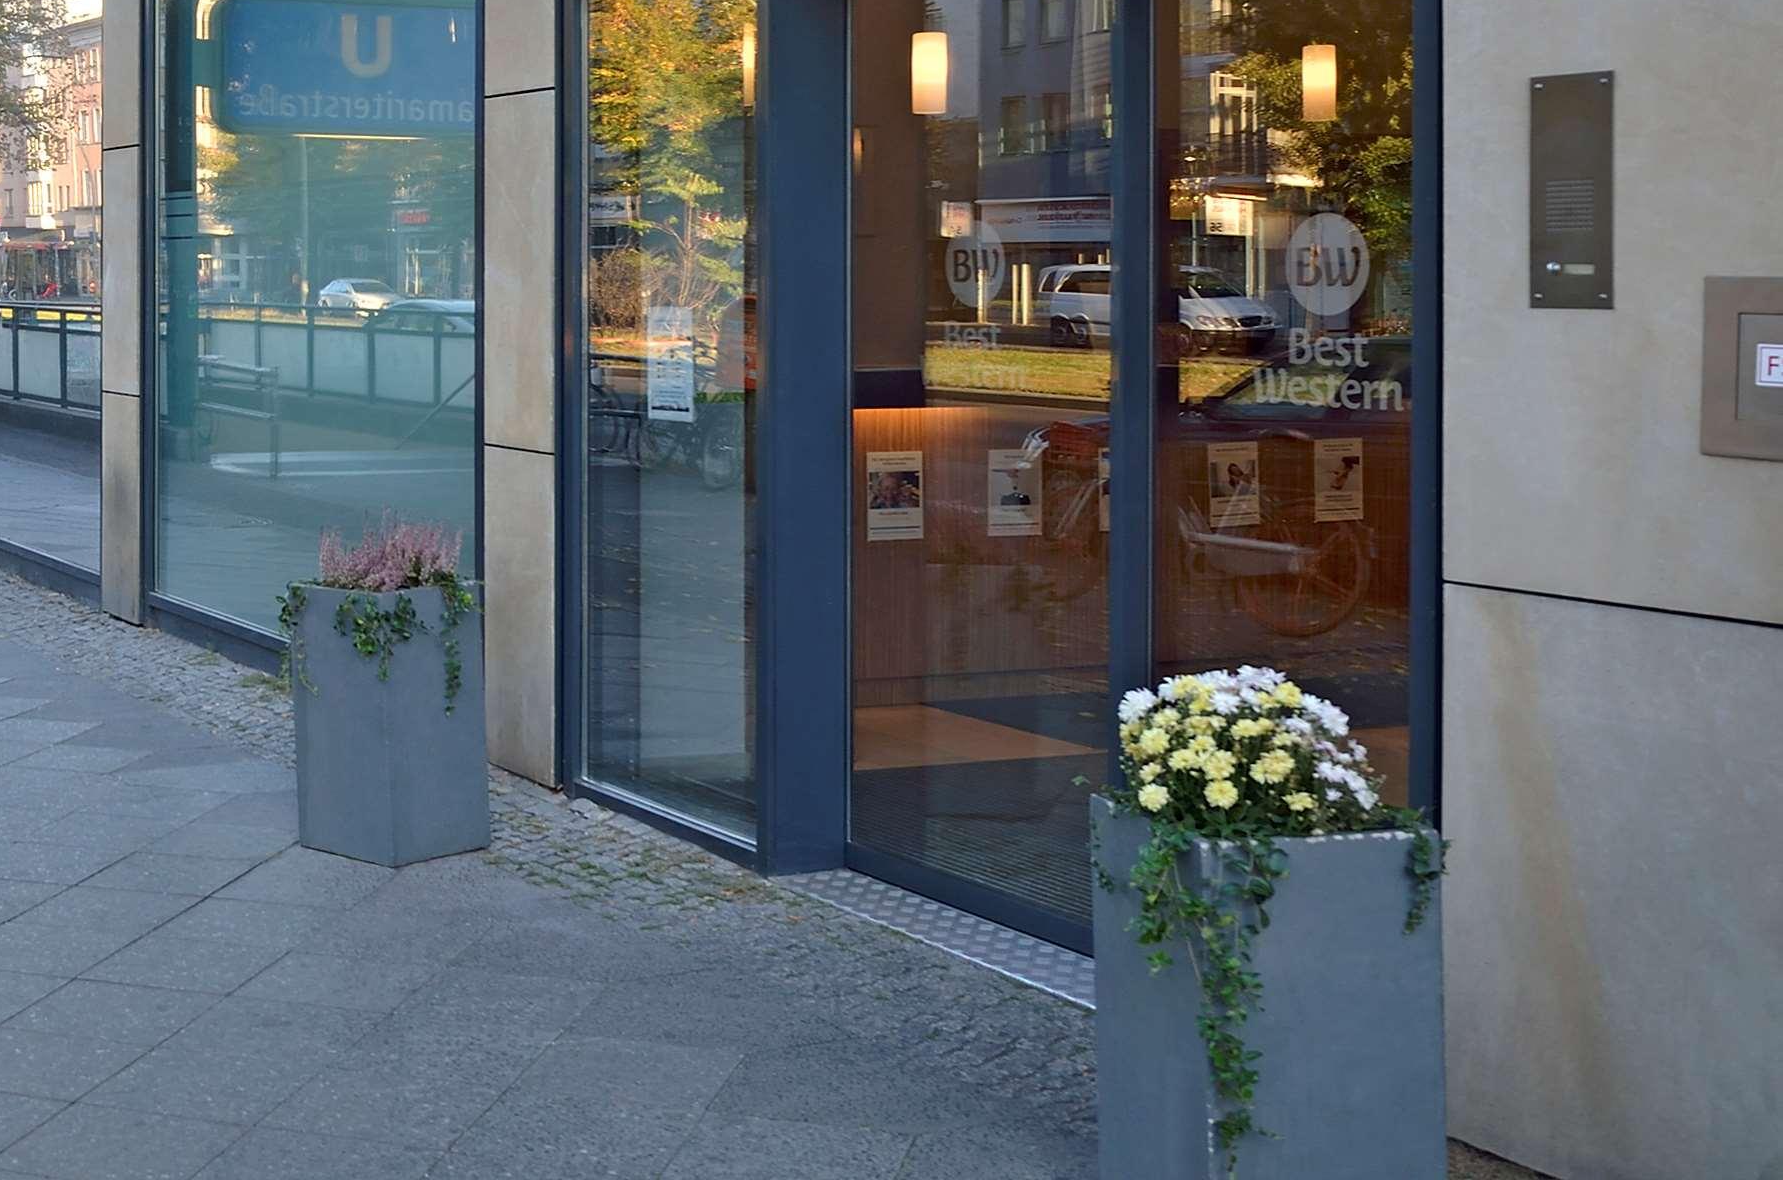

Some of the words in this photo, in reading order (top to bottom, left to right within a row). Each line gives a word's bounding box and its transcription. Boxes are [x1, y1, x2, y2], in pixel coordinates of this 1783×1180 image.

[1294, 246, 1362, 288] BW
[1288, 327, 1370, 368] Best
[1768, 355, 1783, 376] F
[1253, 367, 1405, 412] Western
